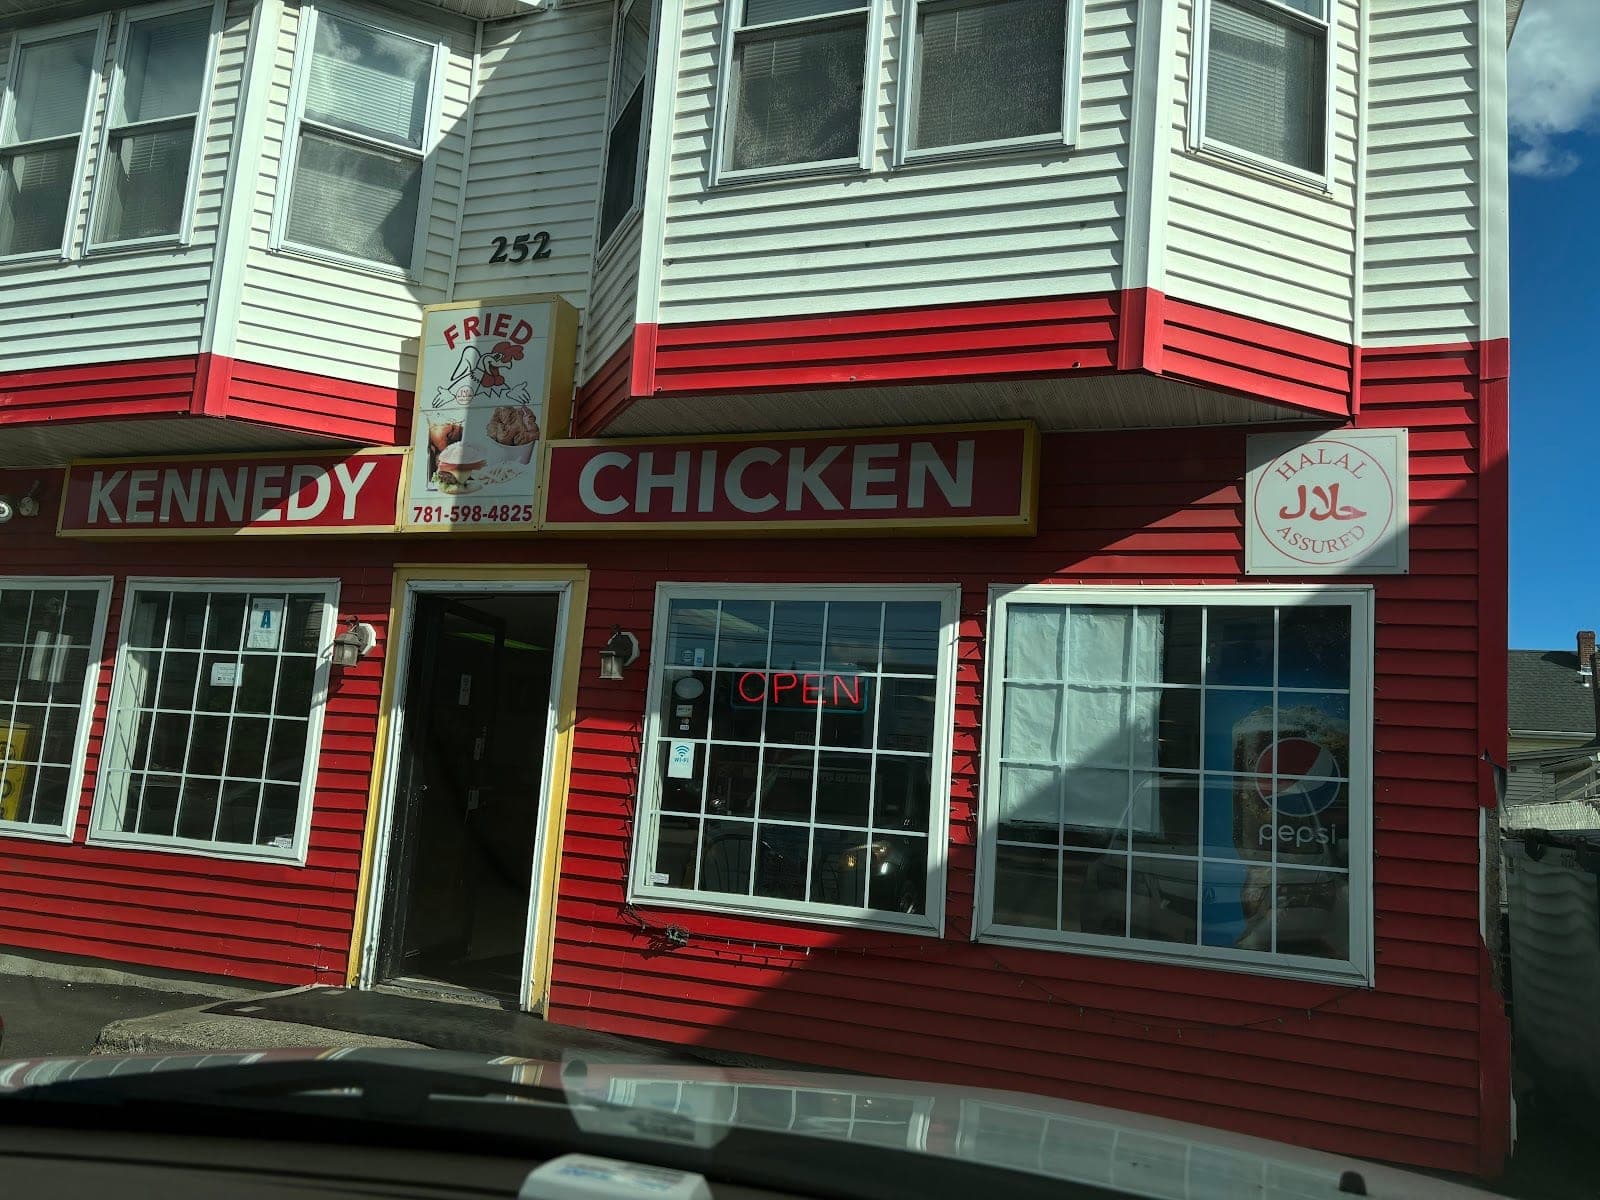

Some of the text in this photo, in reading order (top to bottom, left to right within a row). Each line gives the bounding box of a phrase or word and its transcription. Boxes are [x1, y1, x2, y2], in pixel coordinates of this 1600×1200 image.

[488, 231, 552, 264] 252
[443, 312, 533, 350] FRIED
[578, 439, 976, 516] CHICKEN
[1275, 448, 1367, 481] HALAL
[87, 461, 378, 524] KENNEDY
[1279, 482, 1368, 521] حلال
[413, 504, 533, 523] 781-598-4825
[1276, 524, 1366, 554] ASSURED
[738, 671, 860, 705] OPEN
[1258, 823, 1337, 848] pepsi
